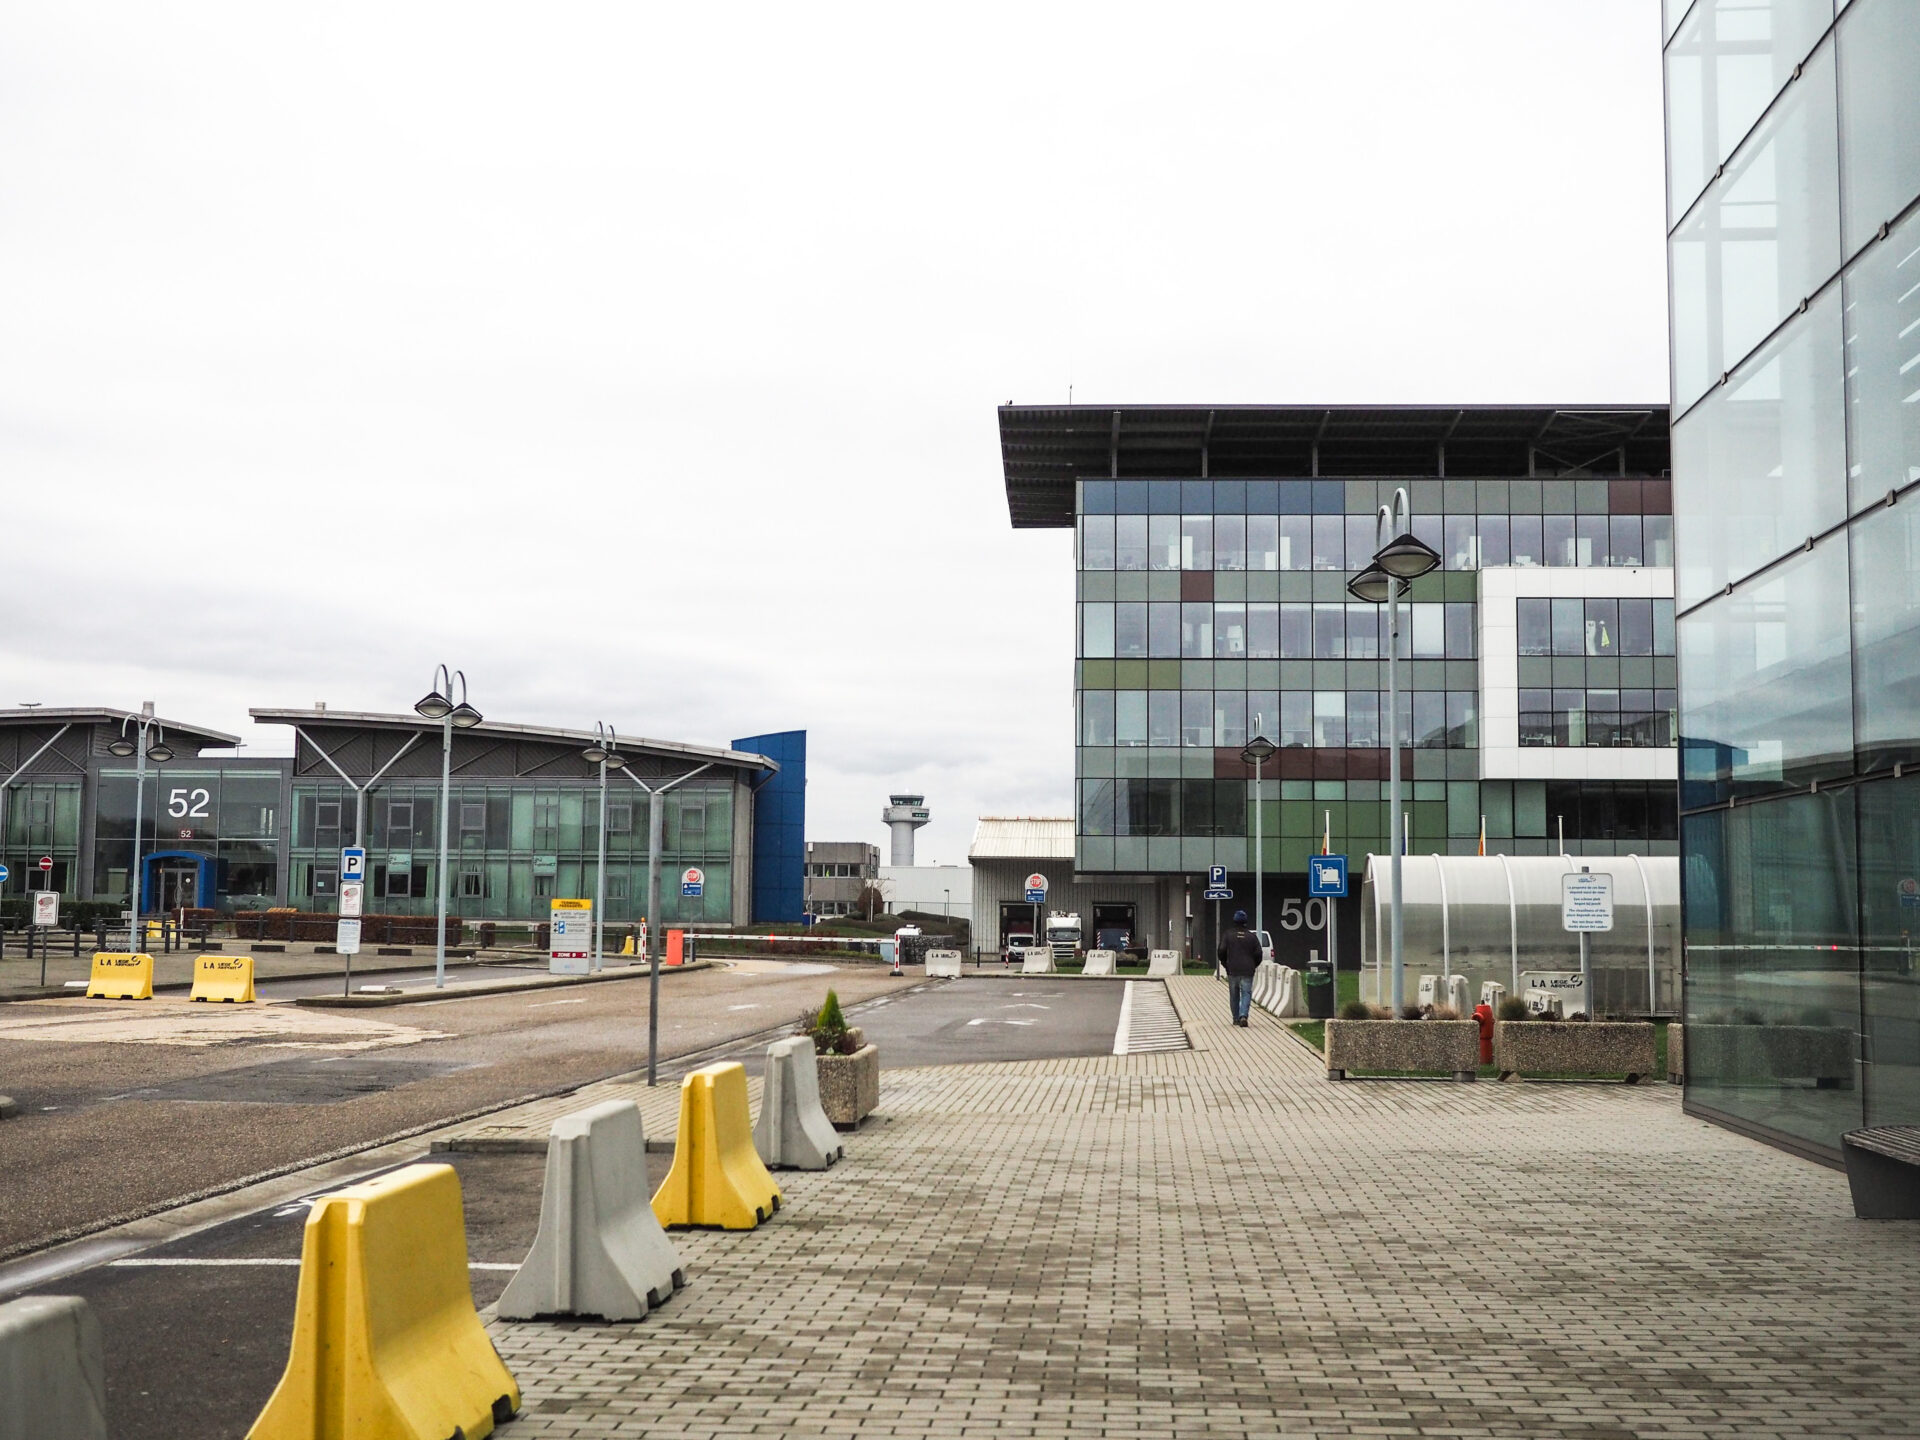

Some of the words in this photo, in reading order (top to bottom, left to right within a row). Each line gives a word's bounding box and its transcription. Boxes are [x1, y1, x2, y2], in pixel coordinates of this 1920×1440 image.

[168, 788, 210, 818] 52
[180, 830, 192, 838] 52
[347, 857, 358, 872] P
[1213, 867, 1223, 881] P
[1280, 897, 1327, 931] 50
